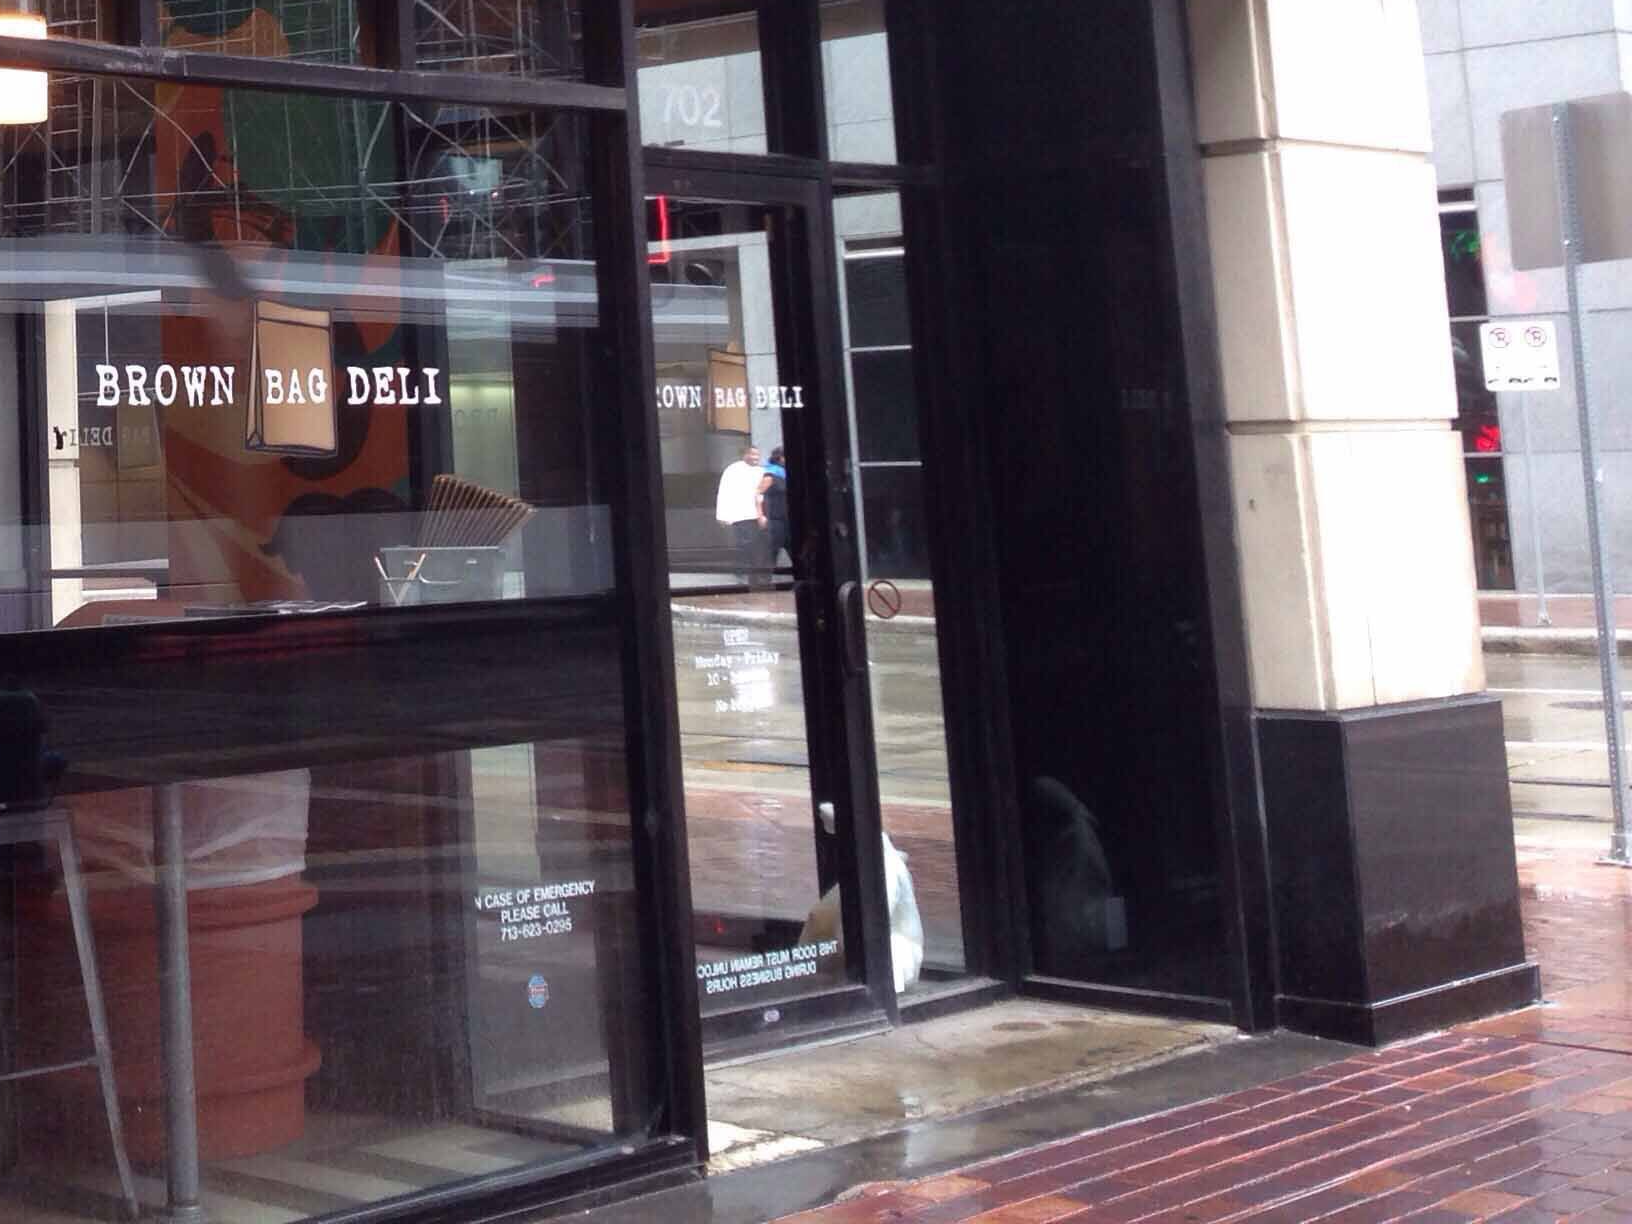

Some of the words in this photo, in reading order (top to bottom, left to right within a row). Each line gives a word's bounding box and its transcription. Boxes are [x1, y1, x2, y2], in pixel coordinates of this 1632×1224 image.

[658, 84, 723, 128] 702
[95, 364, 236, 407] BROWN
[265, 367, 328, 405] BAG
[346, 366, 443, 407] DELI
[656, 384, 702, 409] OWN
[714, 387, 748, 409] BAG
[755, 384, 805, 410] DELI
[484, 891, 514, 909] CASE
[516, 888, 531, 905] OF
[533, 879, 596, 902] EMERGENCY
[500, 905, 542, 924] PLEASE
[542, 901, 571, 918] CALL
